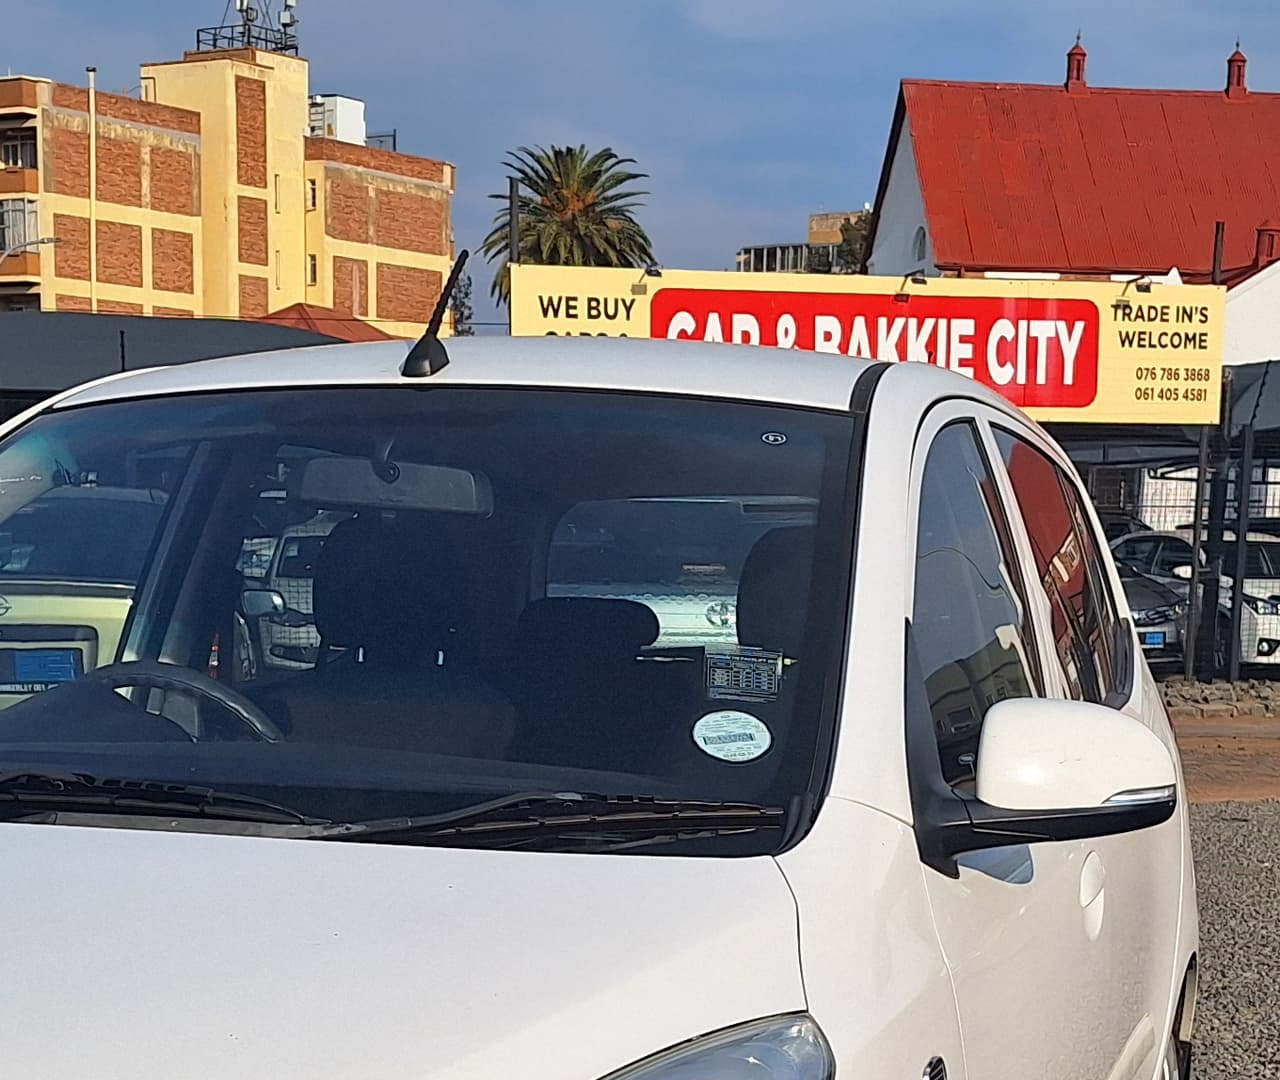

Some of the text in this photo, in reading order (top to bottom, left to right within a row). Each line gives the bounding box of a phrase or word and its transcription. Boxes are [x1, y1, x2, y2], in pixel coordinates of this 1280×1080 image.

[538, 295, 636, 321] WE BUY
[1111, 304, 1209, 324] TRADE IN'S
[1118, 331, 1209, 350] WELCOME
[987, 318, 1086, 386] CITY
[1136, 367, 1210, 381] 076 786 3868
[1135, 387, 1207, 401] 061 405 4581
